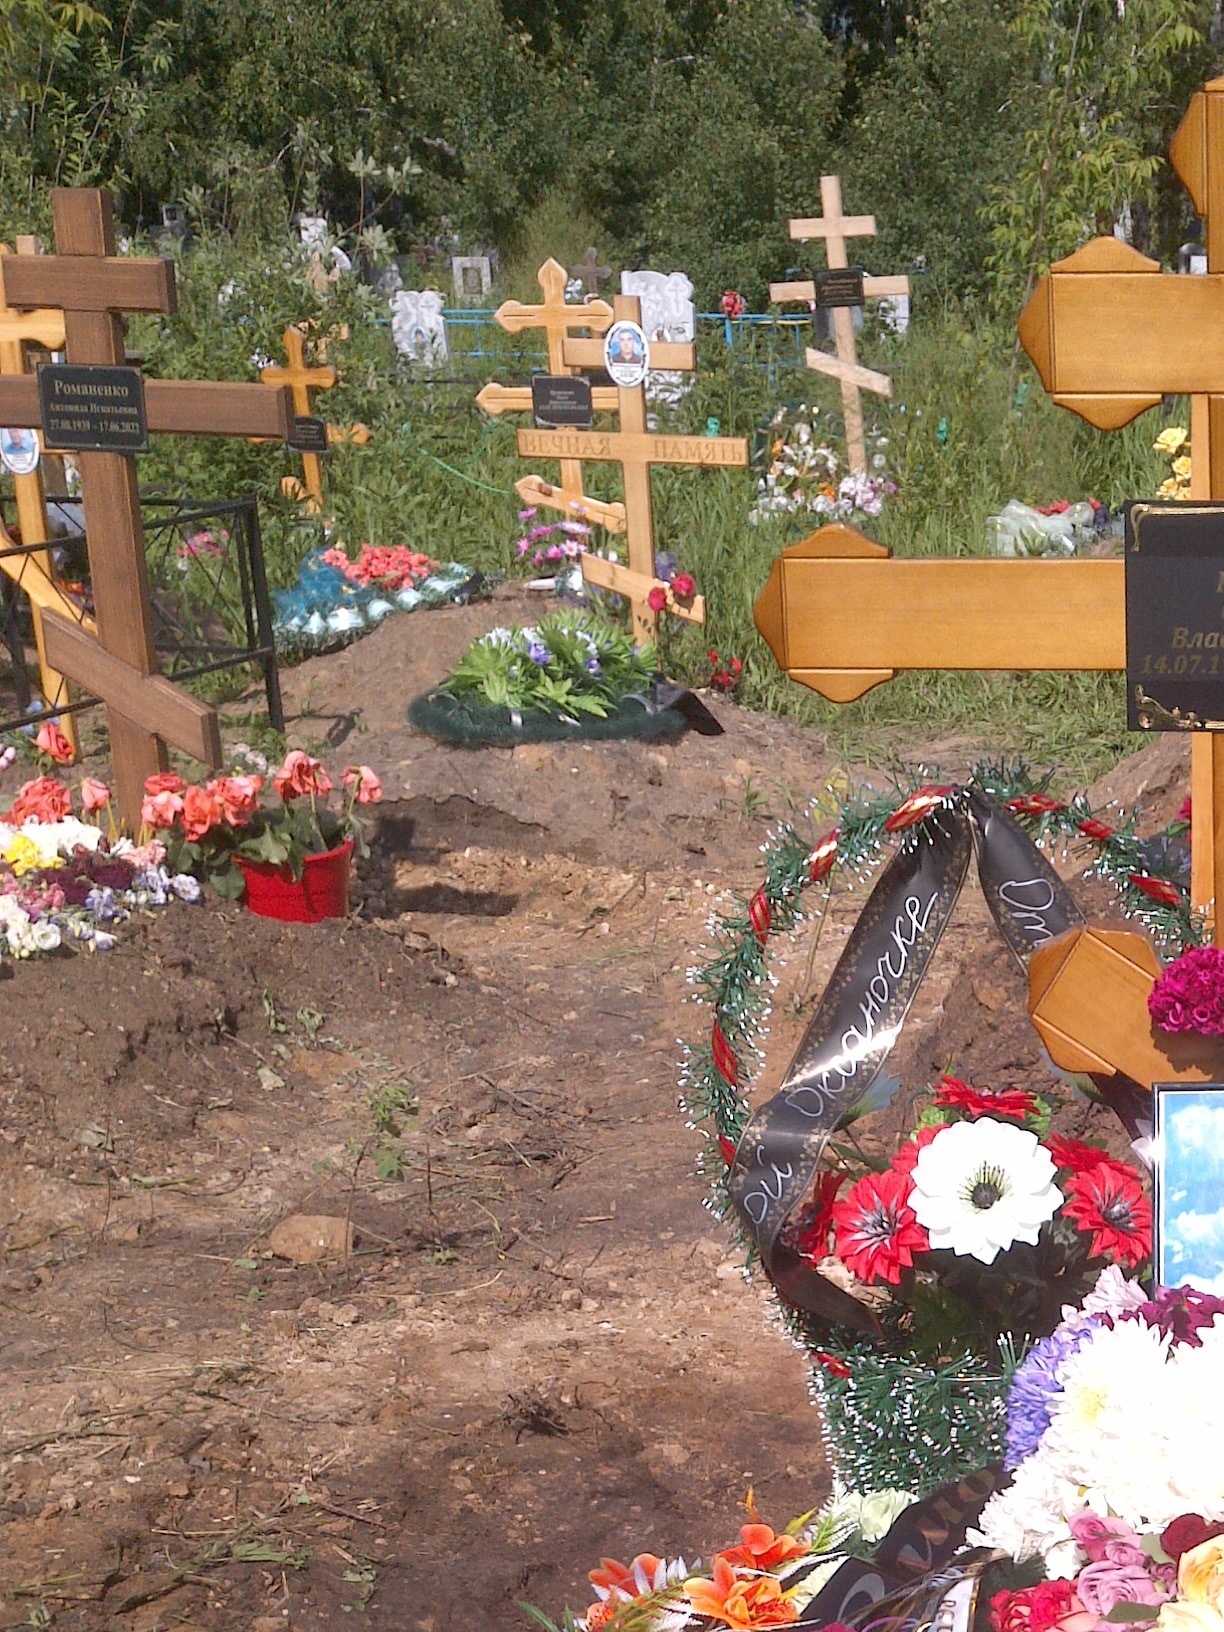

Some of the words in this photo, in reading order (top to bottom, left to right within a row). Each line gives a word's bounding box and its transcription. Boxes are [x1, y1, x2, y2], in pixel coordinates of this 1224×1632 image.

[54, 379, 129, 398] Романенко
[522, 434, 612, 457] ВЕЧНАЯ
[652, 439, 743, 462] ПАМЯТЬ
